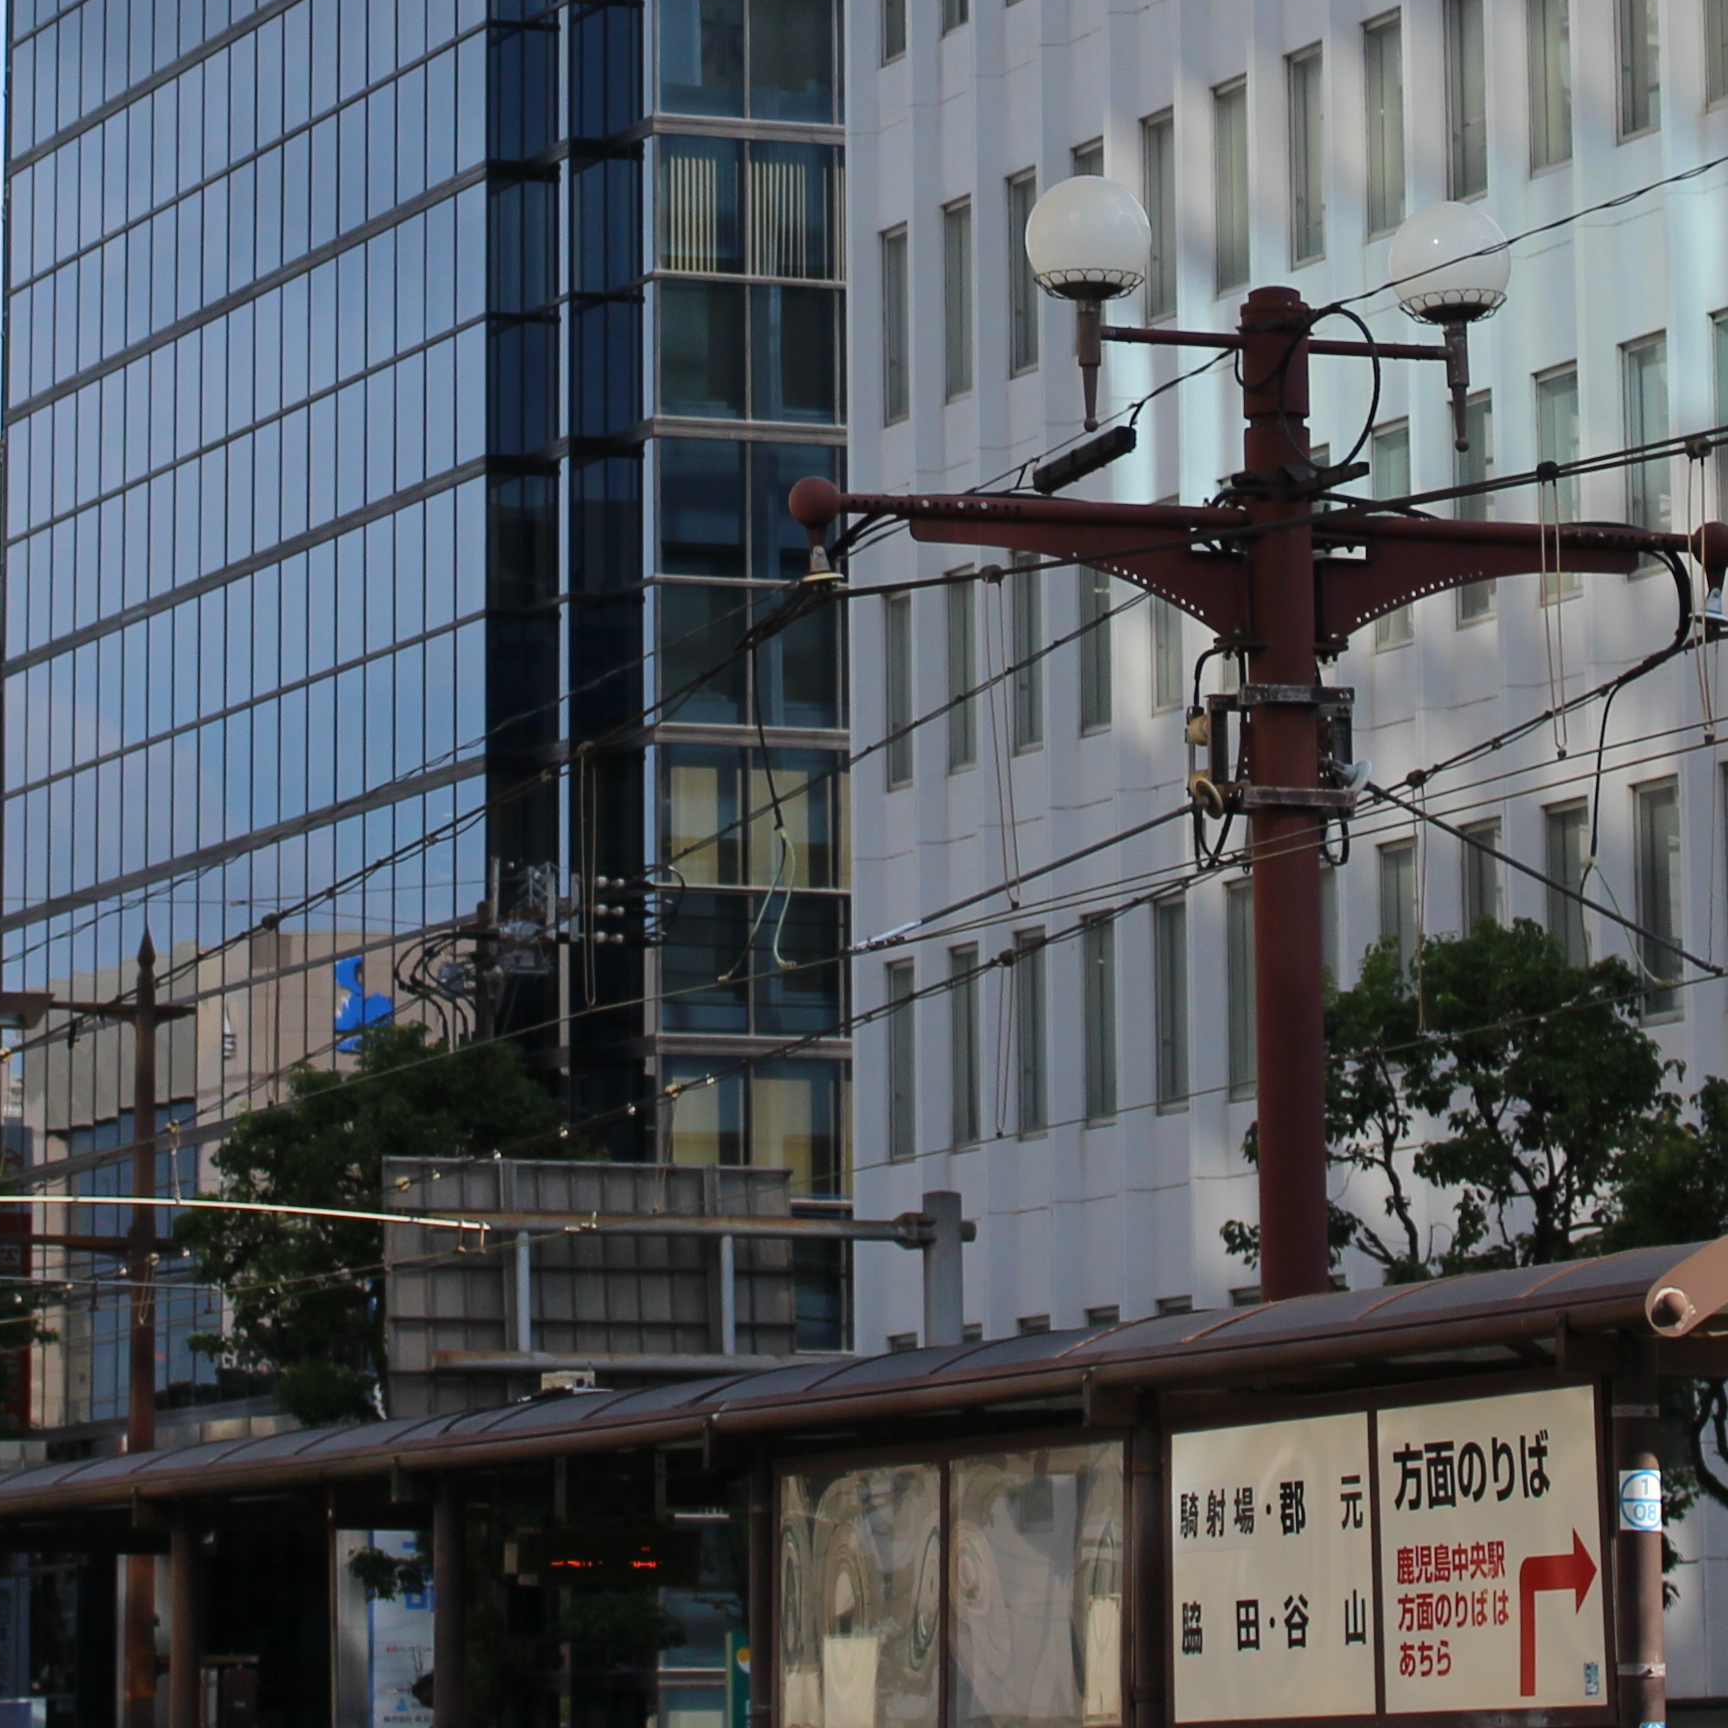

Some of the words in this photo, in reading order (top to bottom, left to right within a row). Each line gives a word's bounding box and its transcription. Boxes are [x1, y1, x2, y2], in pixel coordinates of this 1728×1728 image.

[1393, 1429, 1551, 1511] 方面のりば
[1640, 1477, 1649, 1496] 1
[1633, 1503, 1657, 1521] 08
[1396, 1540, 1506, 1584] 鹿児島中央駅
[1399, 1639, 1452, 1678] あちら
